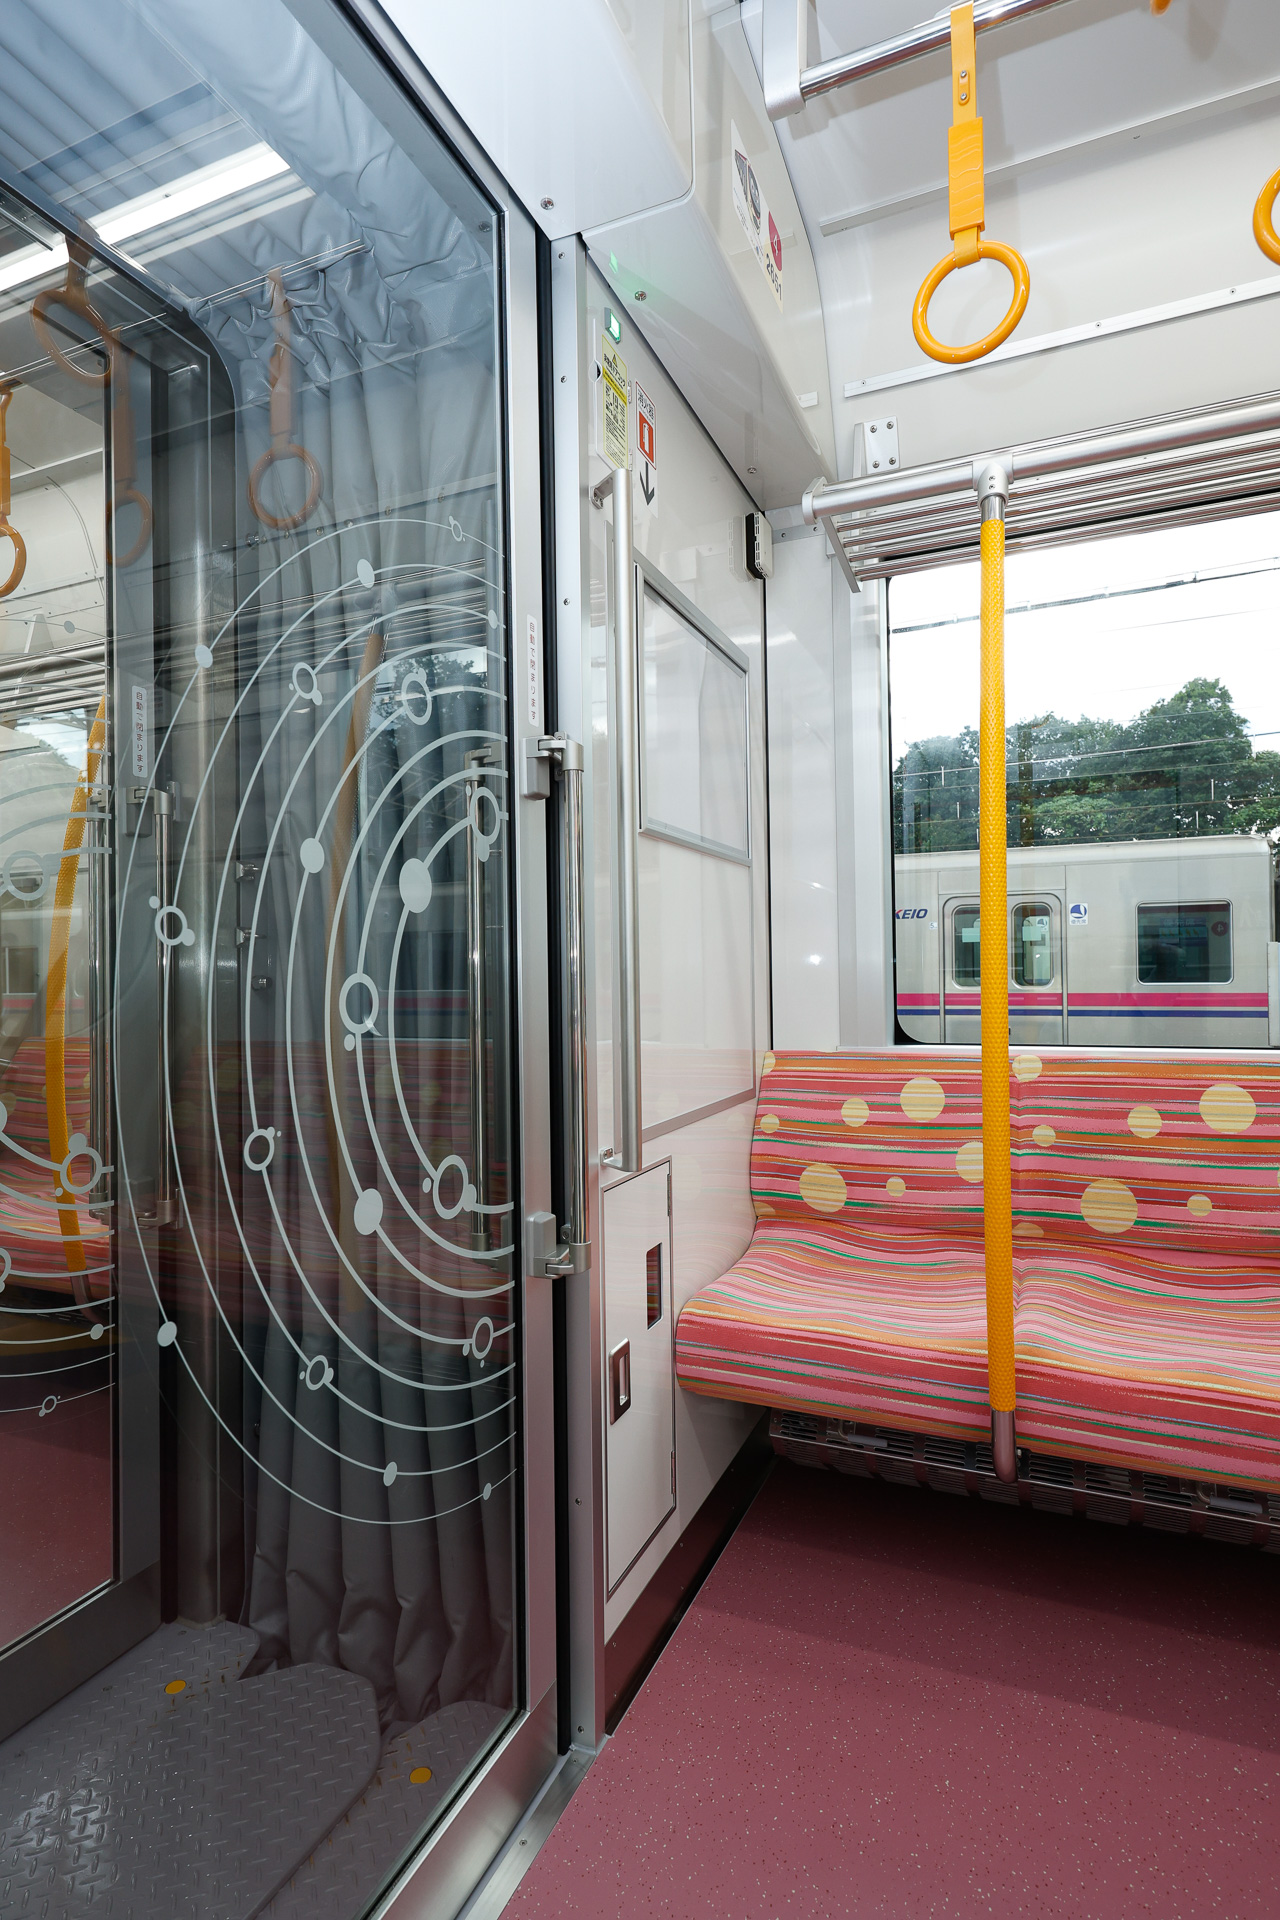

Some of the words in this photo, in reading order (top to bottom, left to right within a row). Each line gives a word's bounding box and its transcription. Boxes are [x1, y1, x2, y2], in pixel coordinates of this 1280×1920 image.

[773, 234, 779, 256] 4
[136, 691, 144, 774] 自動で閉まります
